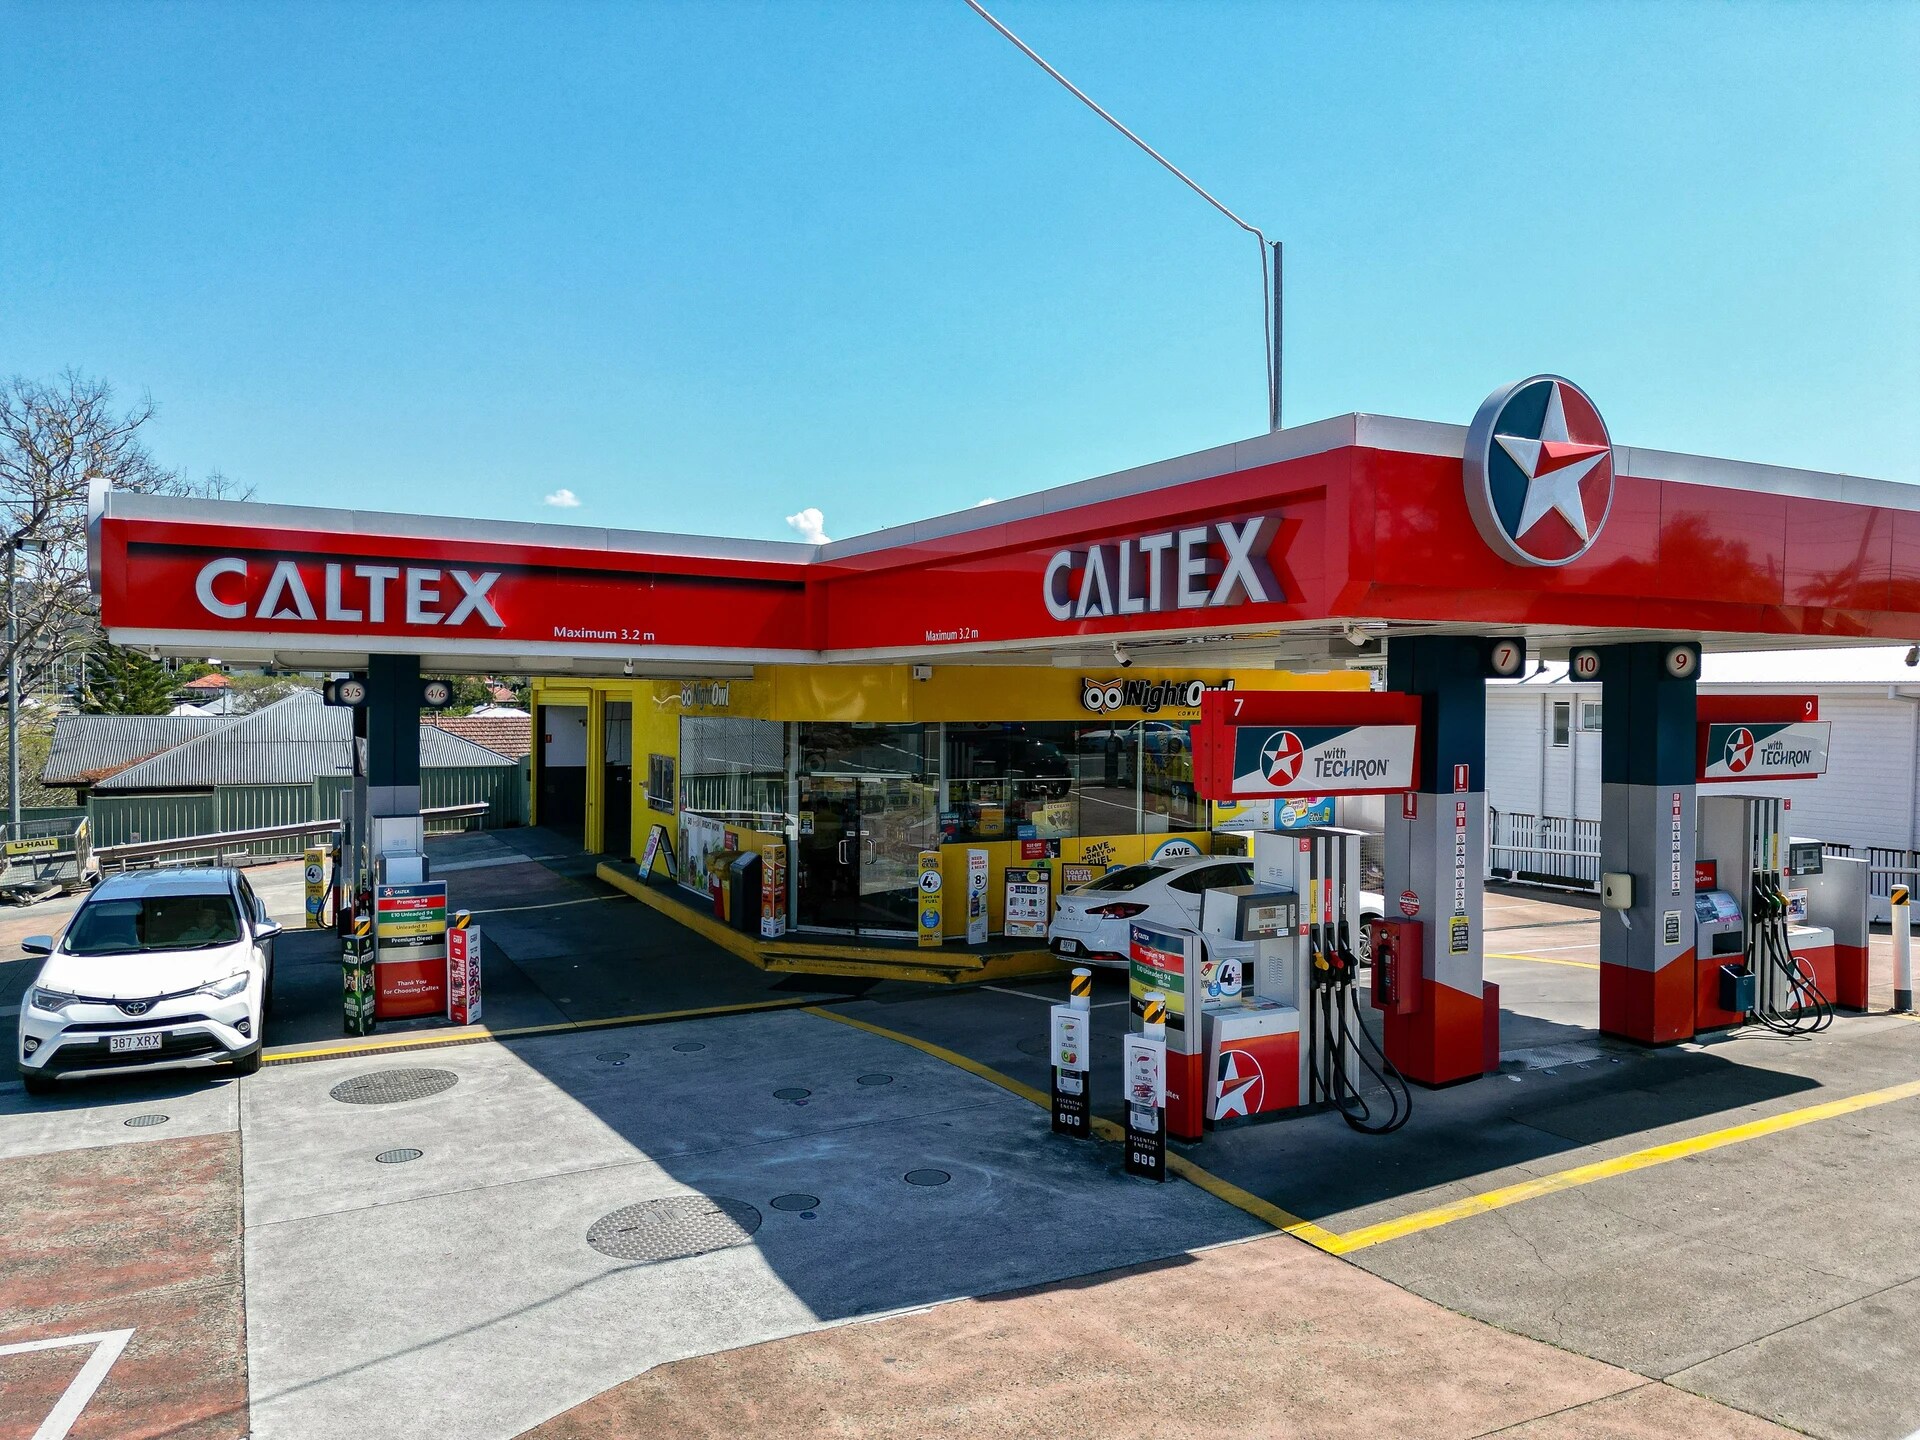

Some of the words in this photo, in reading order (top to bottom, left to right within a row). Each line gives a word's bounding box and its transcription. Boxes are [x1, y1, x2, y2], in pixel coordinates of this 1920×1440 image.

[1043, 516, 1269, 622] CALTEX
[195, 557, 505, 628] CALTEX
[553, 626, 617, 640] Maximum
[620, 628, 641, 641] 3.2
[643, 631, 656, 641] m
[925, 628, 957, 642] Maximum
[958, 627, 970, 640] 3.2
[971, 629, 979, 639] m
[1500, 649, 1511, 667] 7
[1675, 653, 1688, 670] 9
[1578, 656, 1596, 673] 10
[343, 687, 362, 698] 3/5
[428, 689, 446, 698] 4/6
[1234, 699, 1244, 717] 7
[1805, 701, 1813, 715] 9
[1768, 741, 1783, 750] with
[1324, 748, 1346, 759] with
[1761, 749, 1812, 768] TECHRON
[1314, 758, 1388, 780] TECHRON
[14, 840, 54, 850] U-HAUL
[1086, 841, 1110, 854] SAVE
[1081, 850, 1106, 862] MONEY
[1164, 848, 1190, 856] SAVE
[1087, 855, 1112, 865] FUEL
[401, 910, 426, 918] Unleaded
[391, 936, 416, 944] Premium
[1140, 948, 1158, 960] Premium
[1144, 968, 1164, 980] Unleaded
[1164, 974, 1172, 982] 94
[394, 987, 420, 995] Choosing
[112, 1038, 132, 1049] 387
[136, 1035, 160, 1046] XRX
[1136, 1074, 1152, 1083] CELSIUS
[1166, 1090, 1180, 1100] altex
[1056, 1098, 1083, 1107] ESSENTIAL
[1060, 1103, 1080, 1111] ENERGY
[1130, 1134, 1158, 1146] ESSENTIAL
[1134, 1142, 1155, 1150] ENERGY
